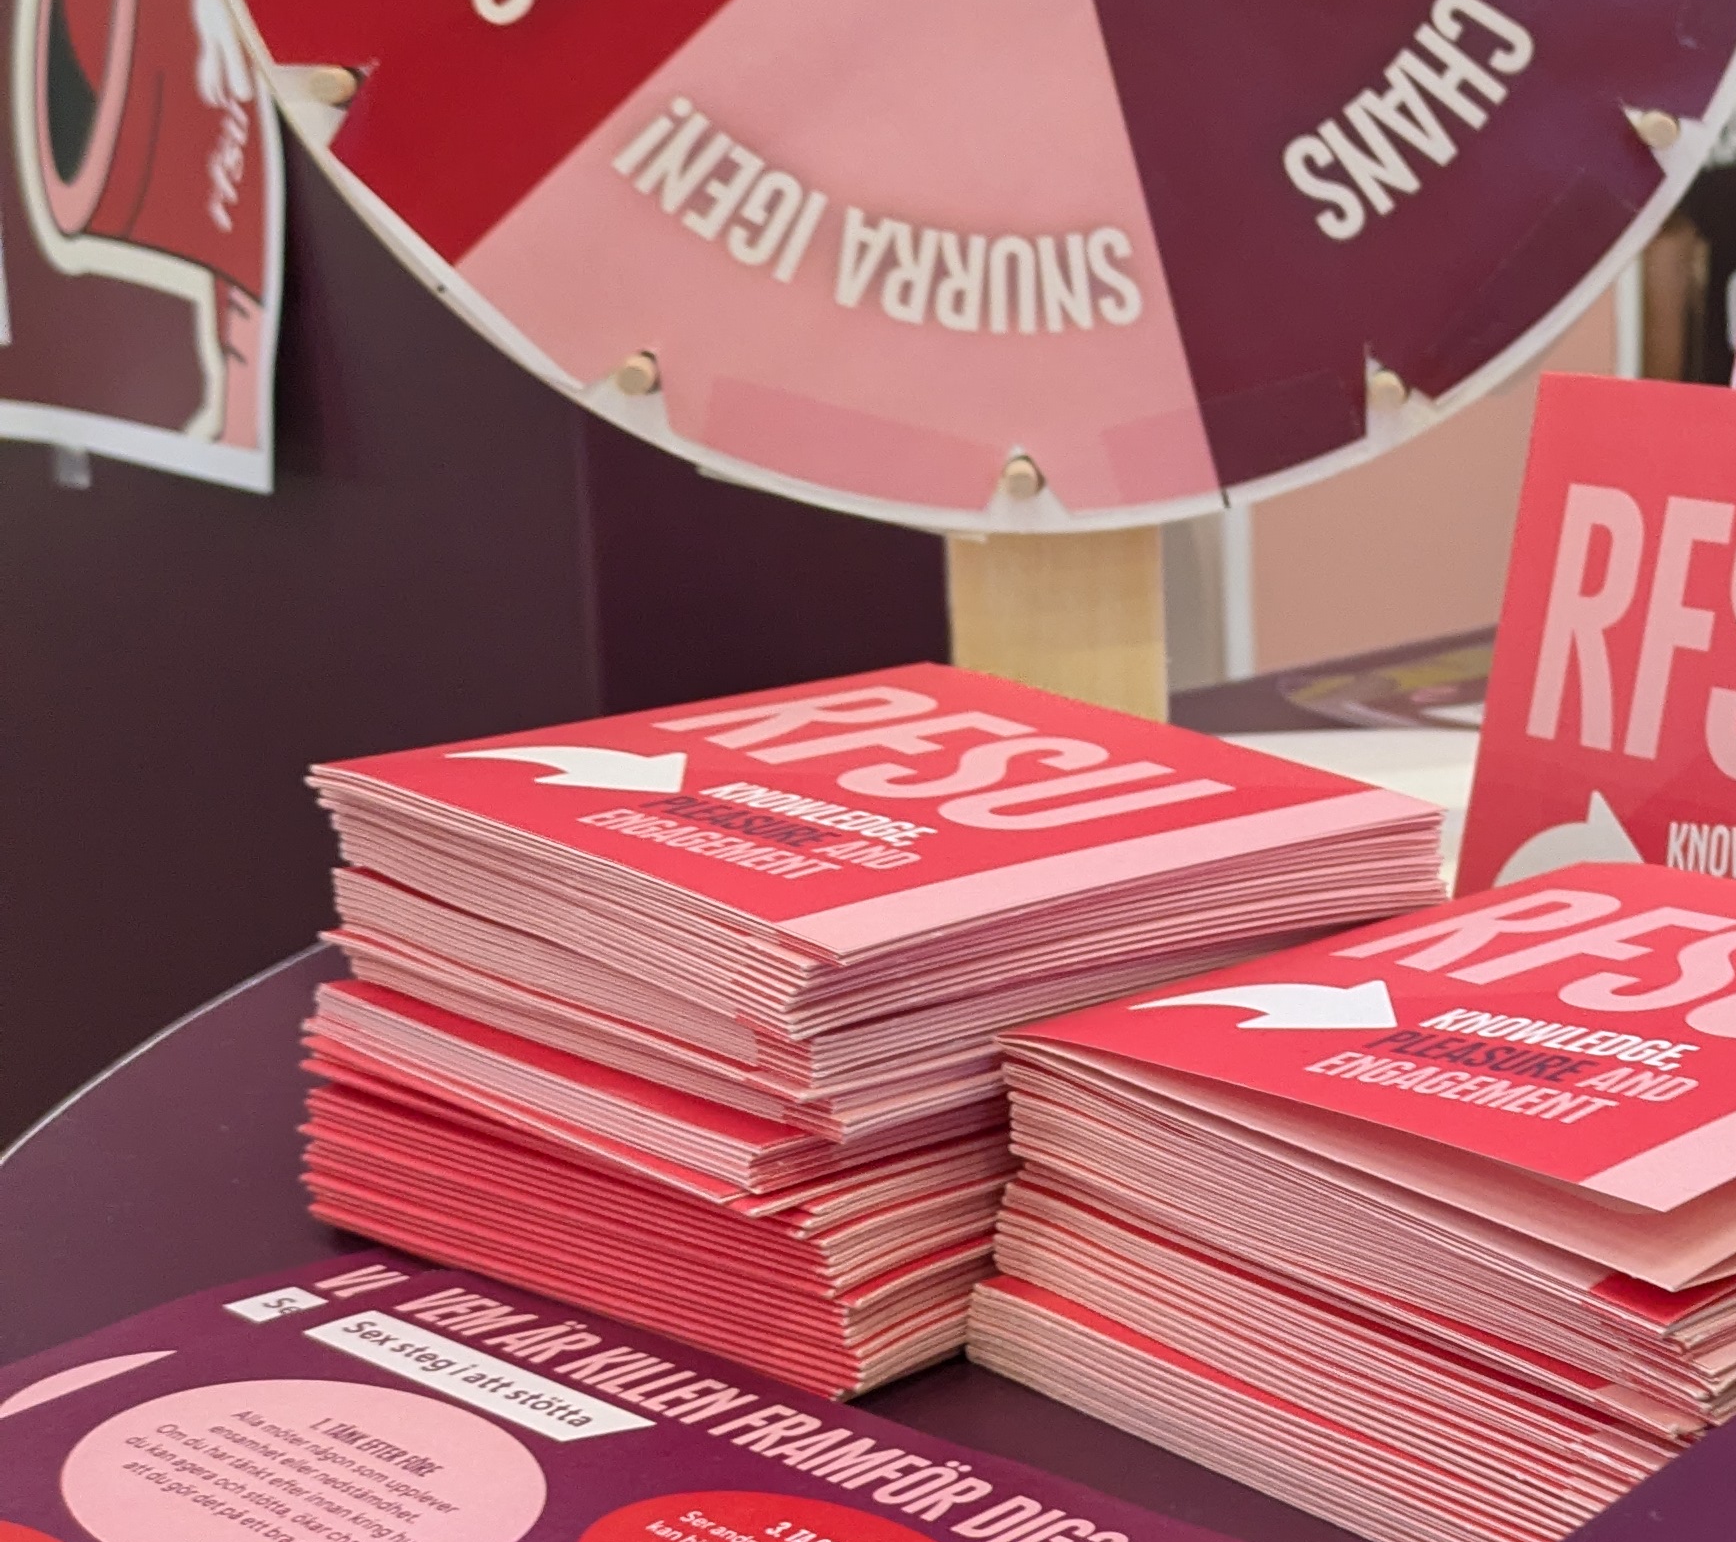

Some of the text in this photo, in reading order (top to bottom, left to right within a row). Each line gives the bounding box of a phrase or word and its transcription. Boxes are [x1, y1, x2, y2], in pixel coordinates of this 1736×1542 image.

[612, 98, 1142, 332] SNURRA IGEN!
[654, 686, 1234, 830] RFSU
[576, 808, 843, 880] ENGAGEMENT
[640, 796, 922, 871] PLEASURE AND
[699, 781, 937, 849] KNOWLEDGE,
[1364, 1030, 1700, 1102] PLEASURE AND
[1419, 1008, 1701, 1071] KNOWLEDGE,
[1305, 1051, 1619, 1125] ENGAGEMENT
[342, 1320, 398, 1349] Sex
[389, 1337, 453, 1373] steg
[462, 1367, 513, 1396] att
[504, 1386, 594, 1429] stötta
[394, 1287, 514, 1336] VEM
[488, 1319, 603, 1364] ÄR
[554, 1346, 757, 1425] KILLEN
[710, 1402, 999, 1522] FRAMFÖR
[646, 1521, 682, 1540] kan
[680, 1511, 716, 1529] Ser
[766, 1522, 792, 1537] 3.
